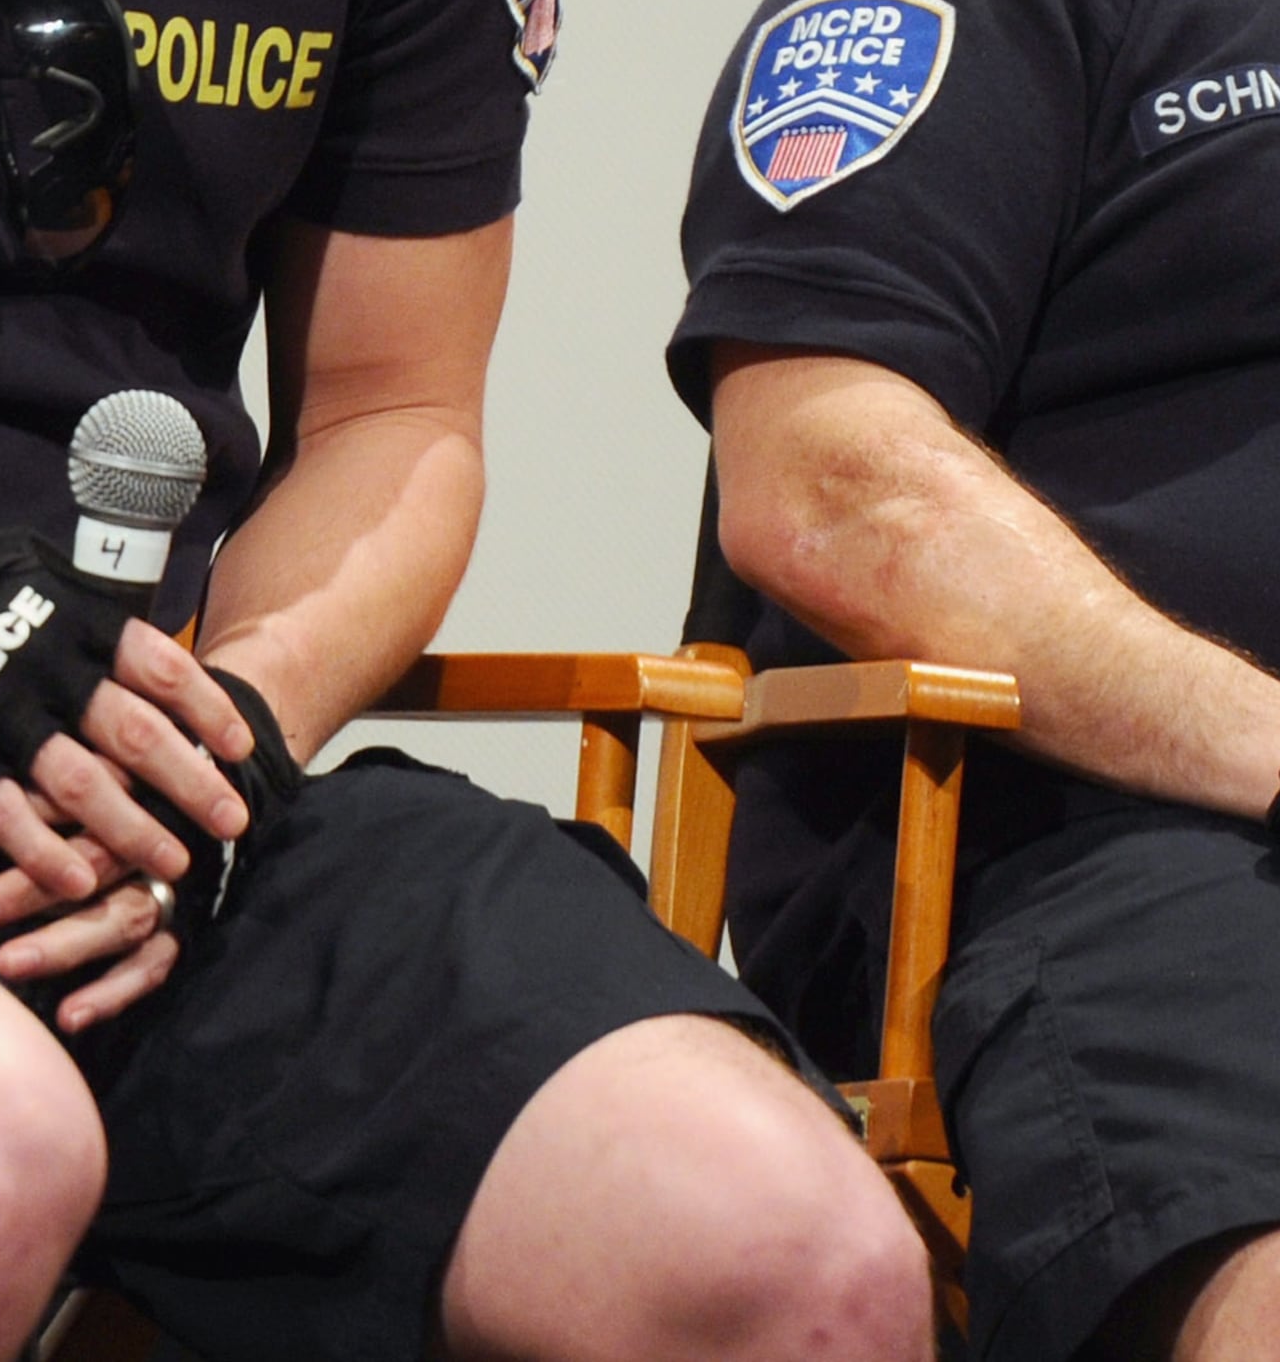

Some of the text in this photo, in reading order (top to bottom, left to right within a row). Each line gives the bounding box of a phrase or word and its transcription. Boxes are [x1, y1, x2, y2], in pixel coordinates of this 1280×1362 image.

[789, 6, 902, 44] MCPD
[123, 10, 334, 110] POLICE
[772, 37, 906, 76] POLICE
[101, 537, 126, 571] 4
